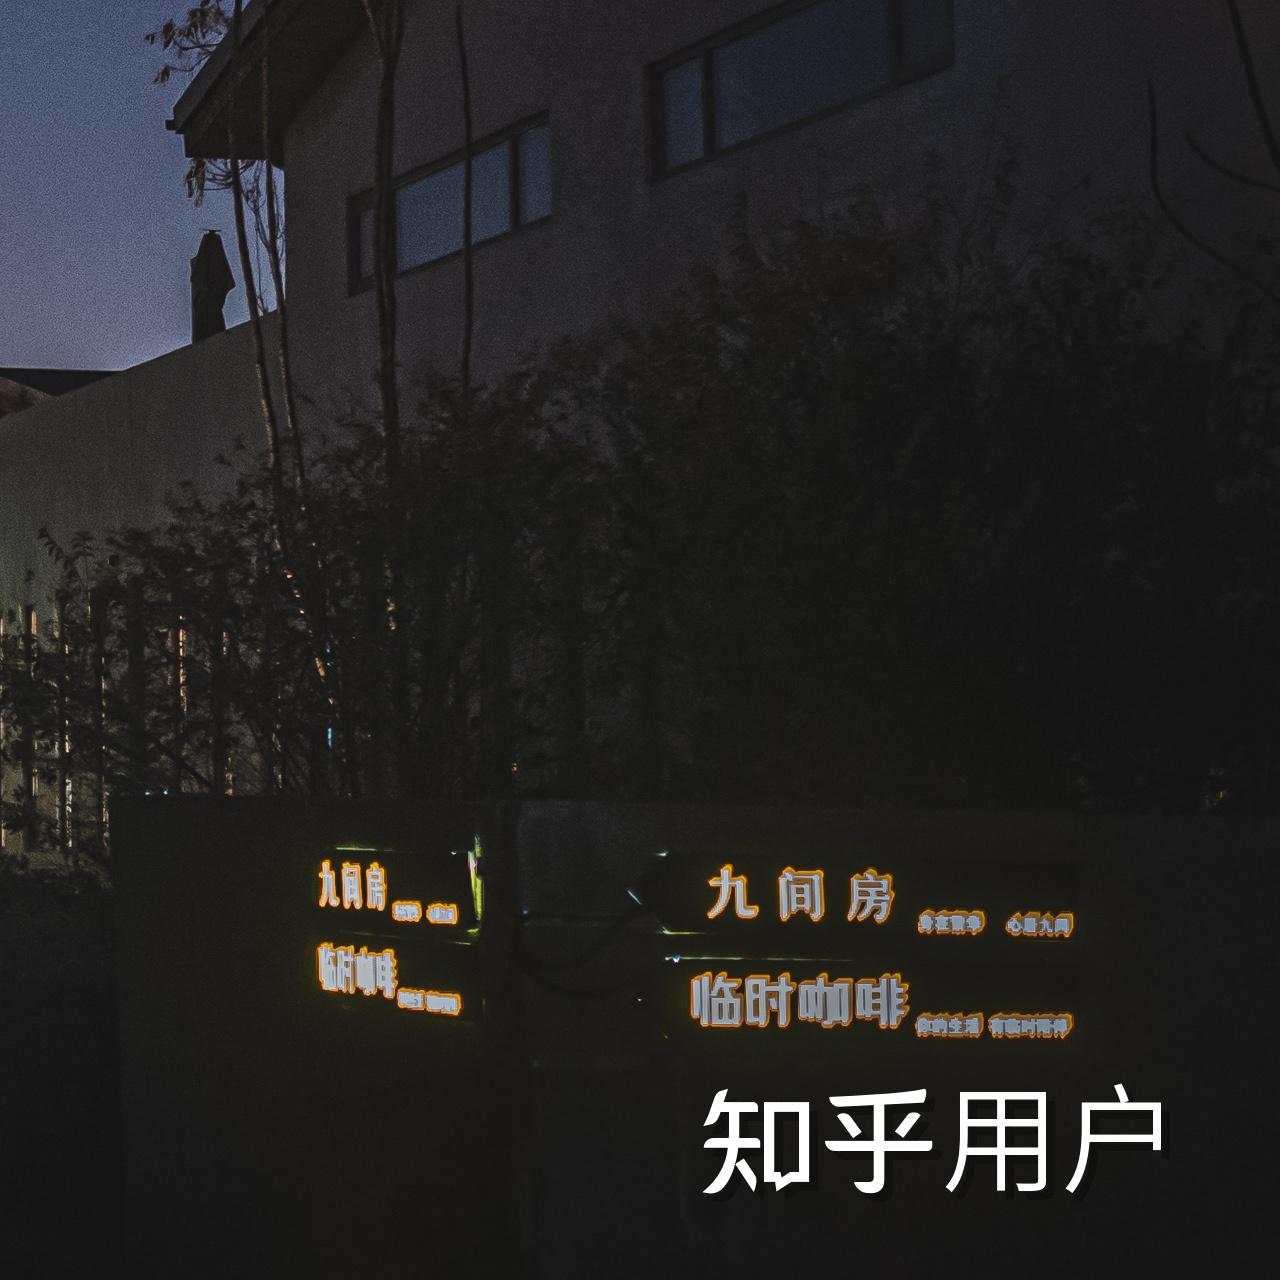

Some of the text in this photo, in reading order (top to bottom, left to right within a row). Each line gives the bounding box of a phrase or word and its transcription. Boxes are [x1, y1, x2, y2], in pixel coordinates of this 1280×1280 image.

[319, 860, 387, 912] 九间房
[707, 865, 895, 923] 九间房
[690, 972, 910, 1029] 临时咖啡
